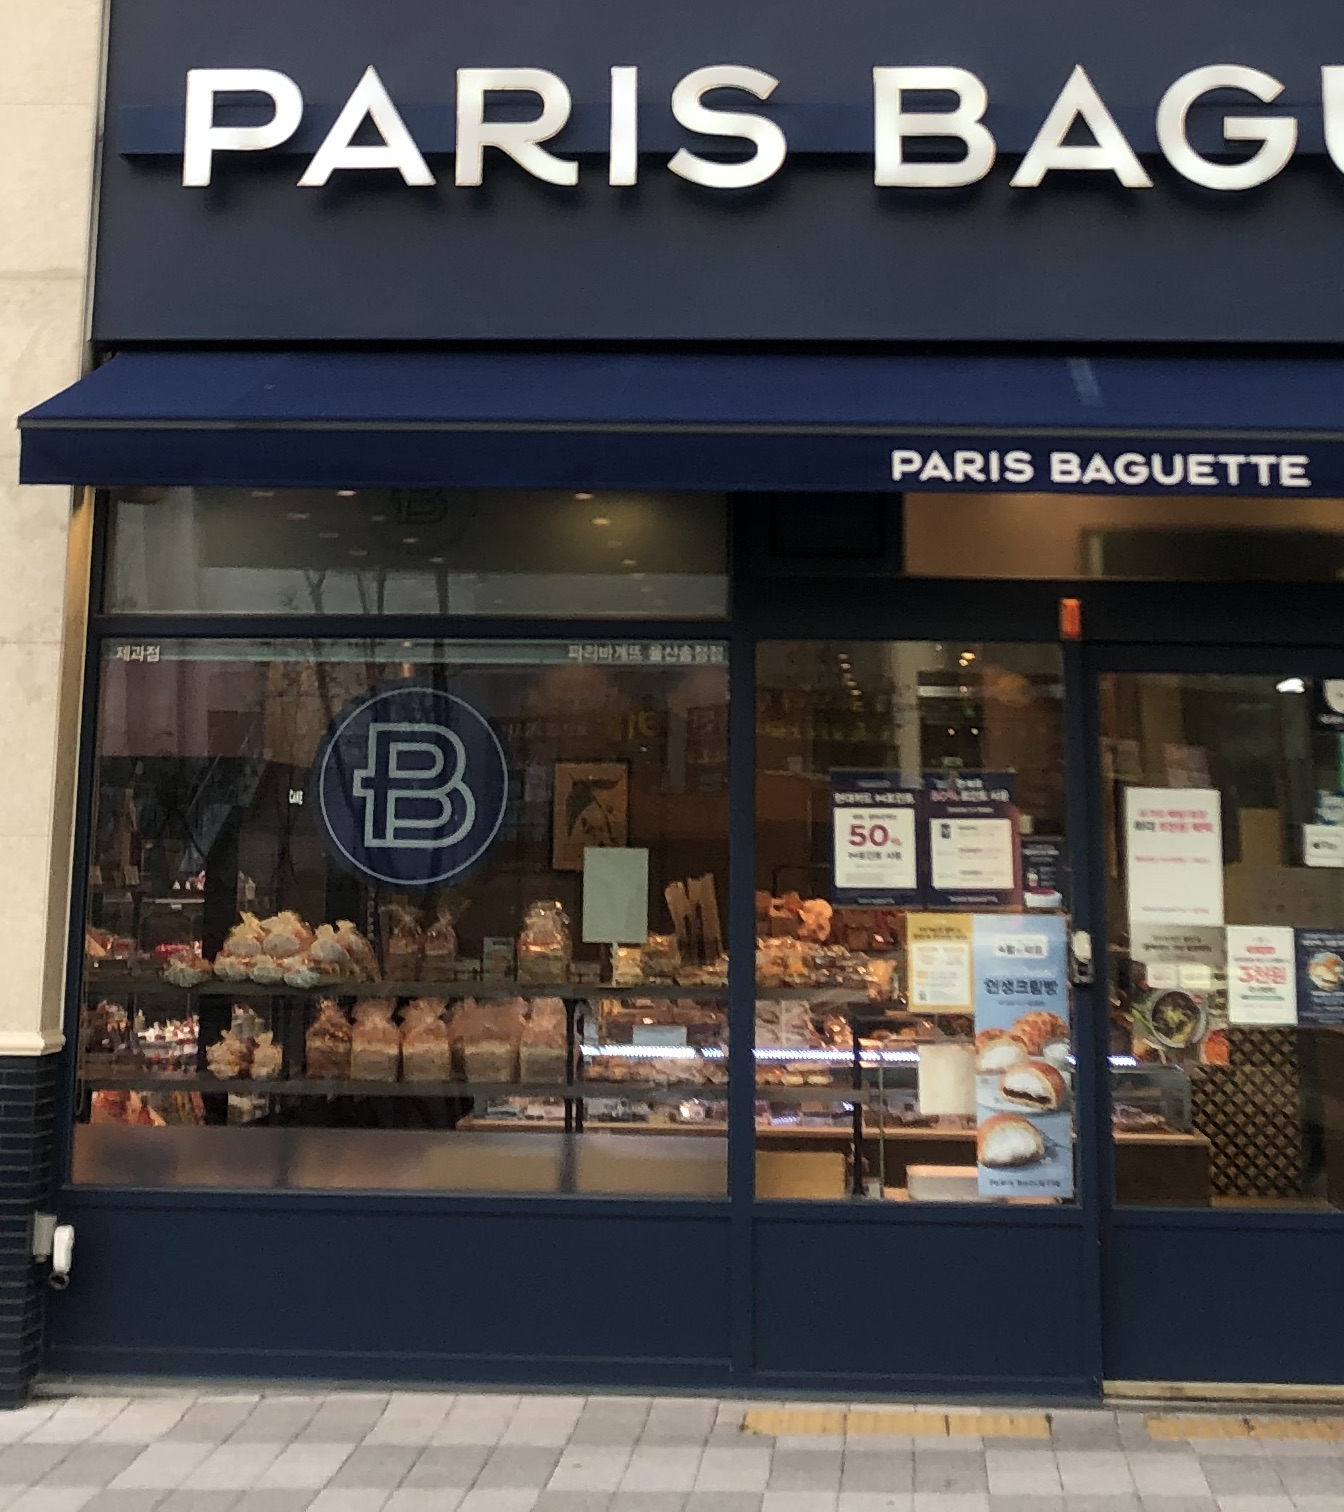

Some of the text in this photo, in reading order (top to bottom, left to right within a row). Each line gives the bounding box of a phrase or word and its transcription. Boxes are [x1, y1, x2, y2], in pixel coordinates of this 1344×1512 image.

[182, 63, 788, 189] PARIS
[890, 450, 1311, 487] PARIS BAGUETTE
[115, 645, 160, 663] 제과점
[567, 643, 642, 662] 파리바게뜨
